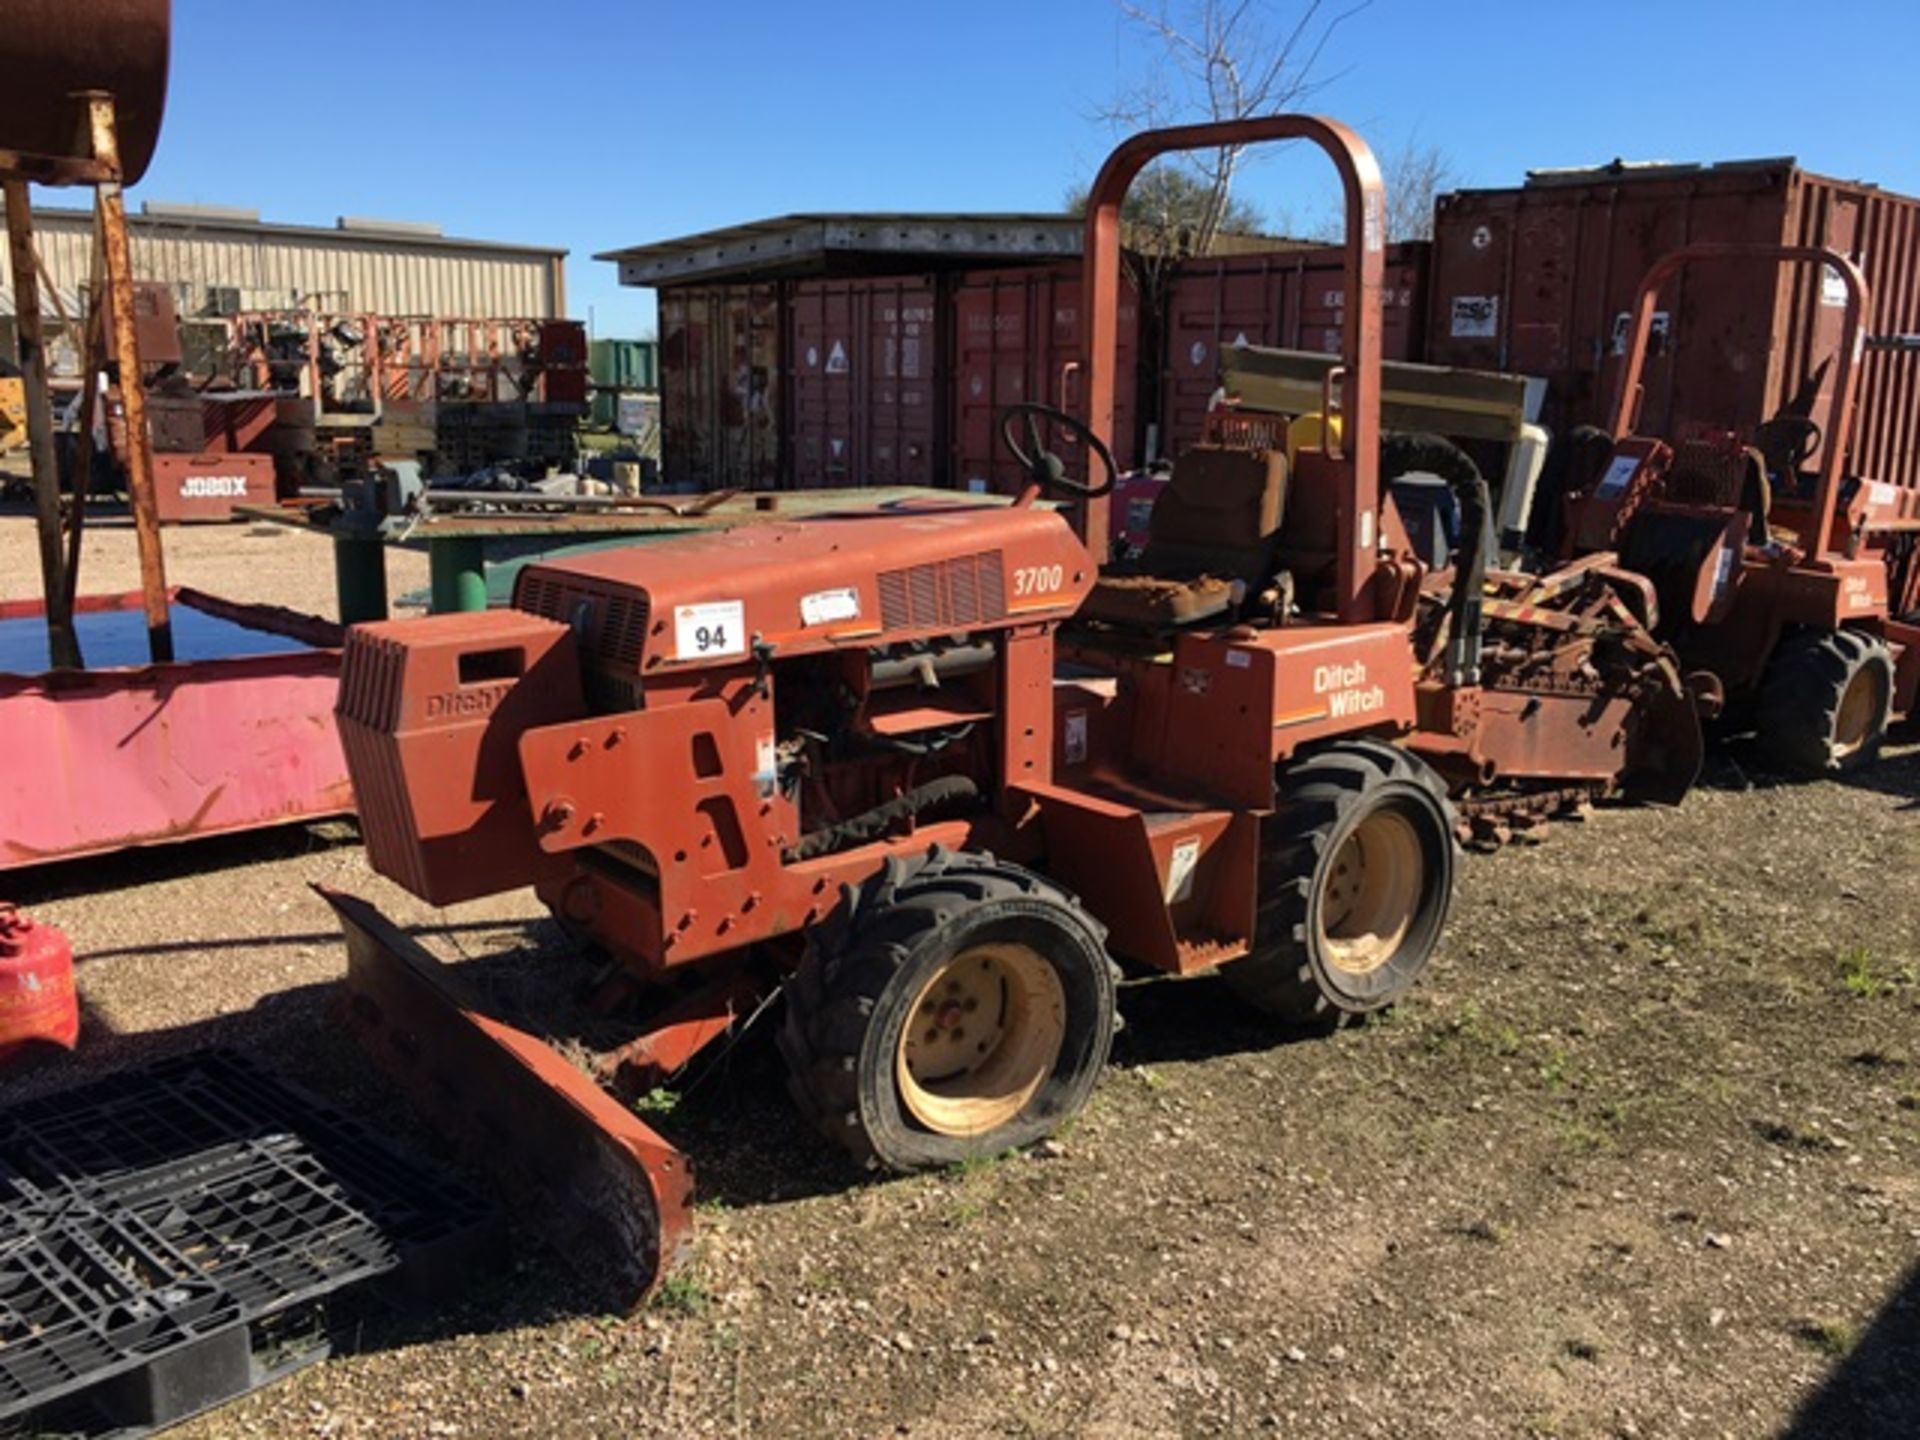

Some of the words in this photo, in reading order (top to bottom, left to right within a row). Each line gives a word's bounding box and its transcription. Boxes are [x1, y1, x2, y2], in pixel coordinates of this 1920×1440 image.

[180, 476, 247, 497] JOBOX
[1013, 564, 1063, 596] 3700
[695, 624, 727, 651] 94
[1313, 660, 1366, 694] Ditch
[1329, 685, 1384, 718] Witch
